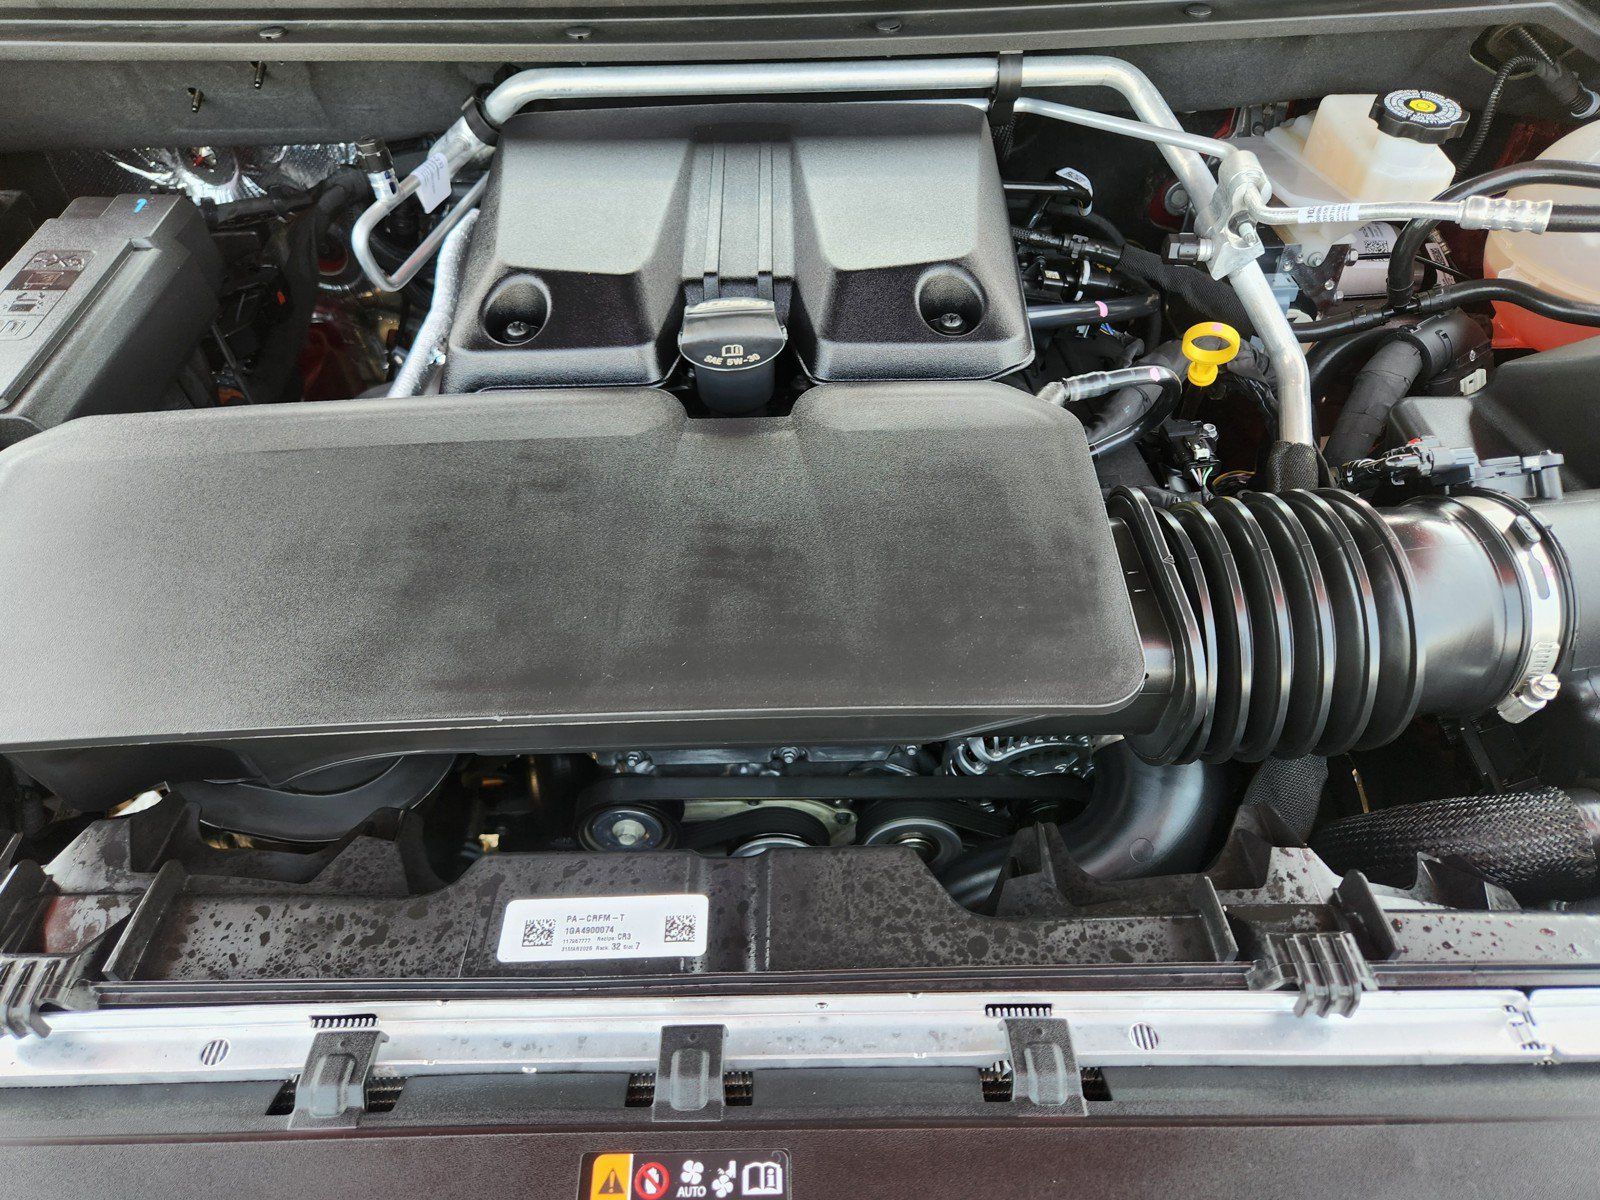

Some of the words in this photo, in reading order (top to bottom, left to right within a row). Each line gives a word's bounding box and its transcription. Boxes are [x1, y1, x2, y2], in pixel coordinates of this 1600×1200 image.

[704, 355, 723, 365] SAE
[611, 942, 621, 951] 32
[635, 942, 641, 950] 7
[676, 1186, 707, 1198] AUTO
